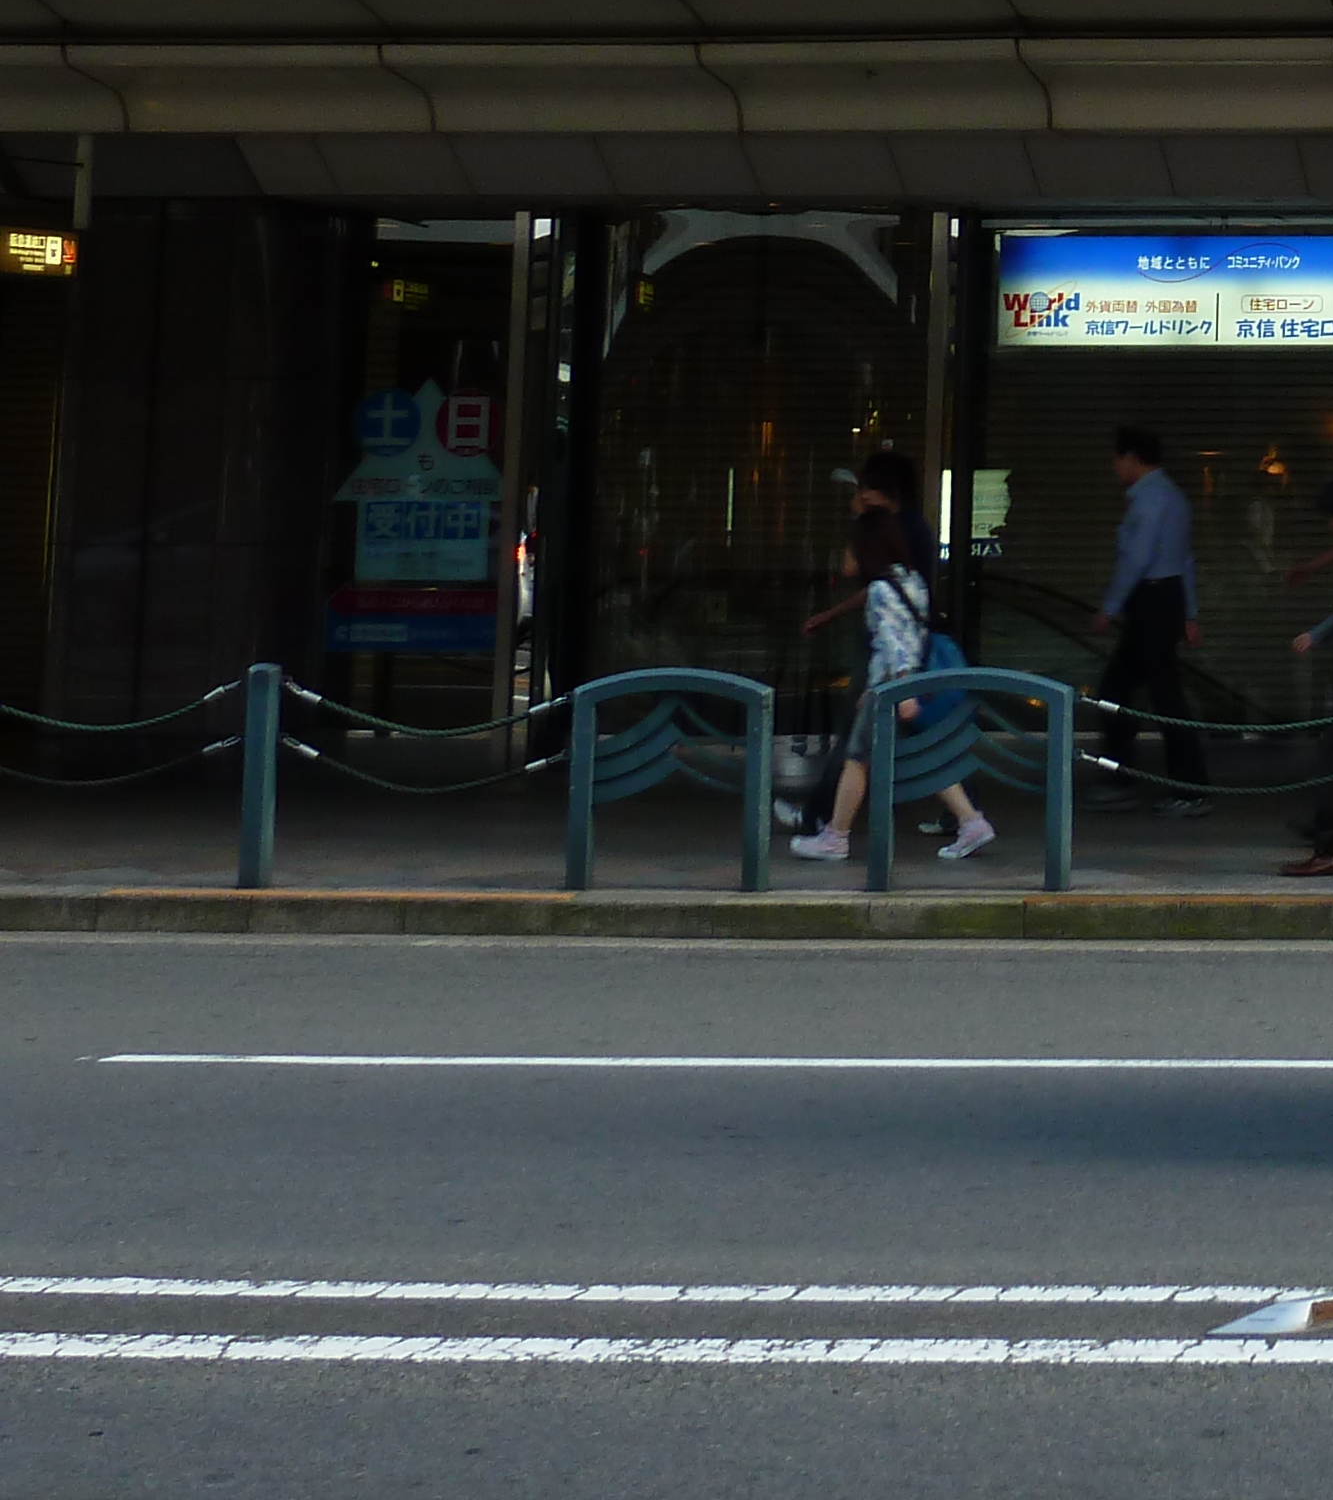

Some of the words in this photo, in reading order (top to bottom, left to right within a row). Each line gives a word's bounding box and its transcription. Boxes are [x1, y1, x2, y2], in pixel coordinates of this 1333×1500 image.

[1137, 255, 1211, 271] 地域とともに
[1003, 291, 1081, 312] World
[1086, 299, 1138, 314] 外貨両替
[1145, 299, 1198, 314] 外国為替
[1248, 297, 1316, 311] 住宅ローン
[1013, 309, 1070, 329] Link
[1085, 319, 1213, 336] 京信ワールドリンク
[1235, 318, 1276, 339] 京信
[361, 392, 411, 446] 土
[447, 395, 490, 448] 日
[365, 501, 481, 540] 受付中
